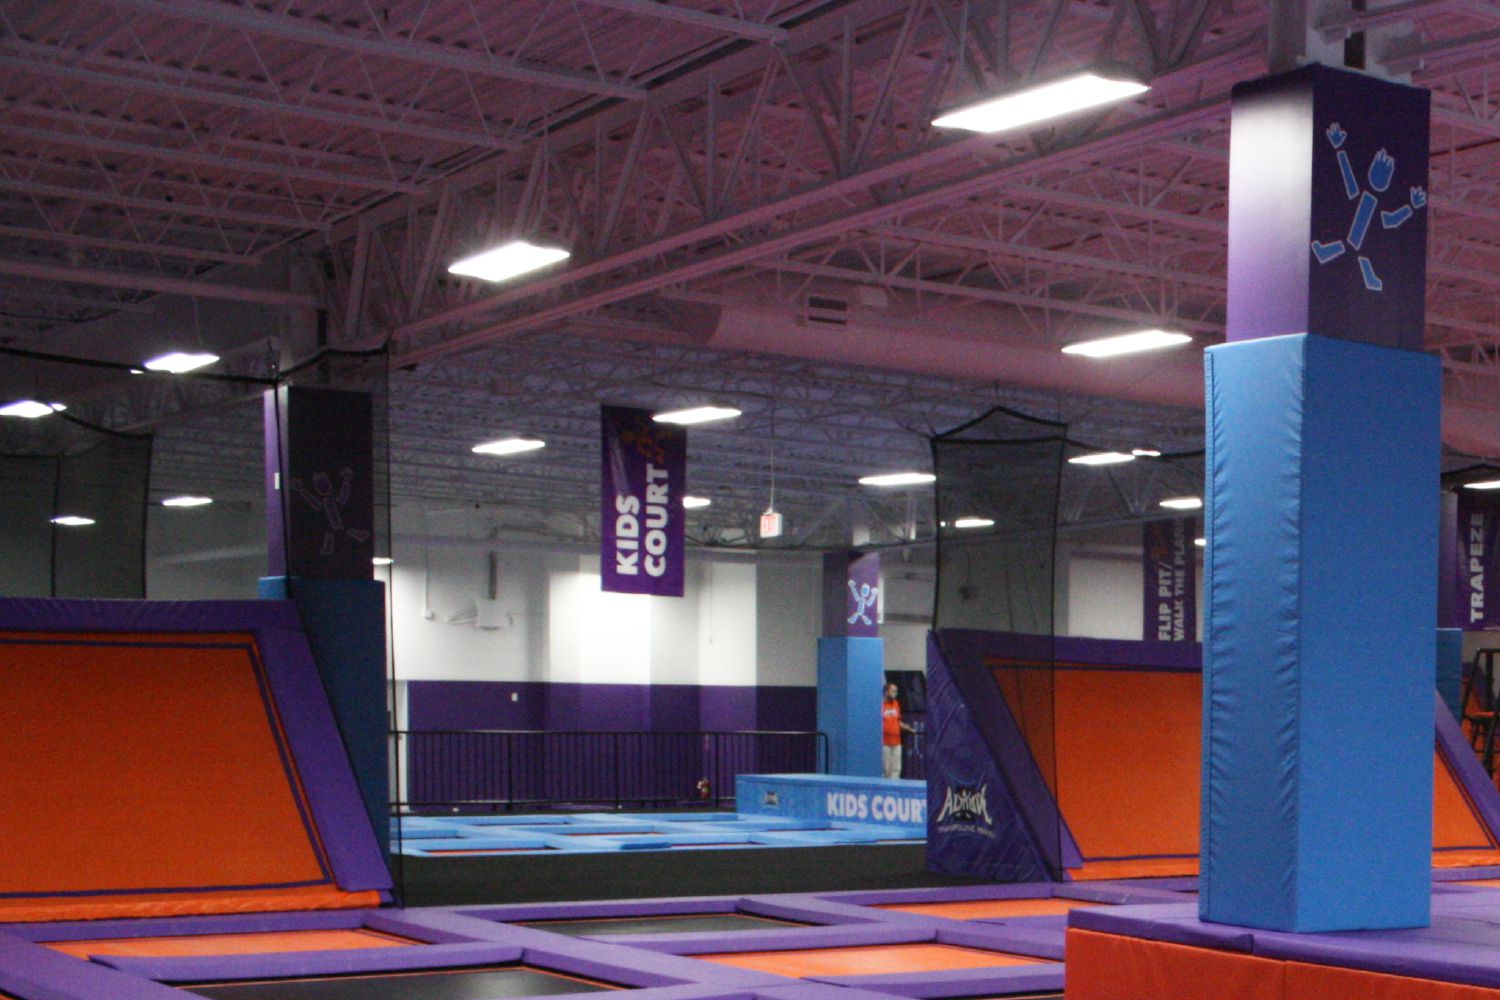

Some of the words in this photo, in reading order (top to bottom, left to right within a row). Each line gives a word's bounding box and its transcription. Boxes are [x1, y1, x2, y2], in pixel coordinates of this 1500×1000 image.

[615, 494, 641, 575] KIDS
[644, 462, 669, 577] COURT
[1174, 569, 1185, 597] THE
[1469, 512, 1484, 624] TRAPEZE
[1158, 603, 1172, 641] FLIP
[1173, 600, 1185, 642] WALK
[826, 792, 868, 819] KIDS
[871, 794, 927, 823] COUR
